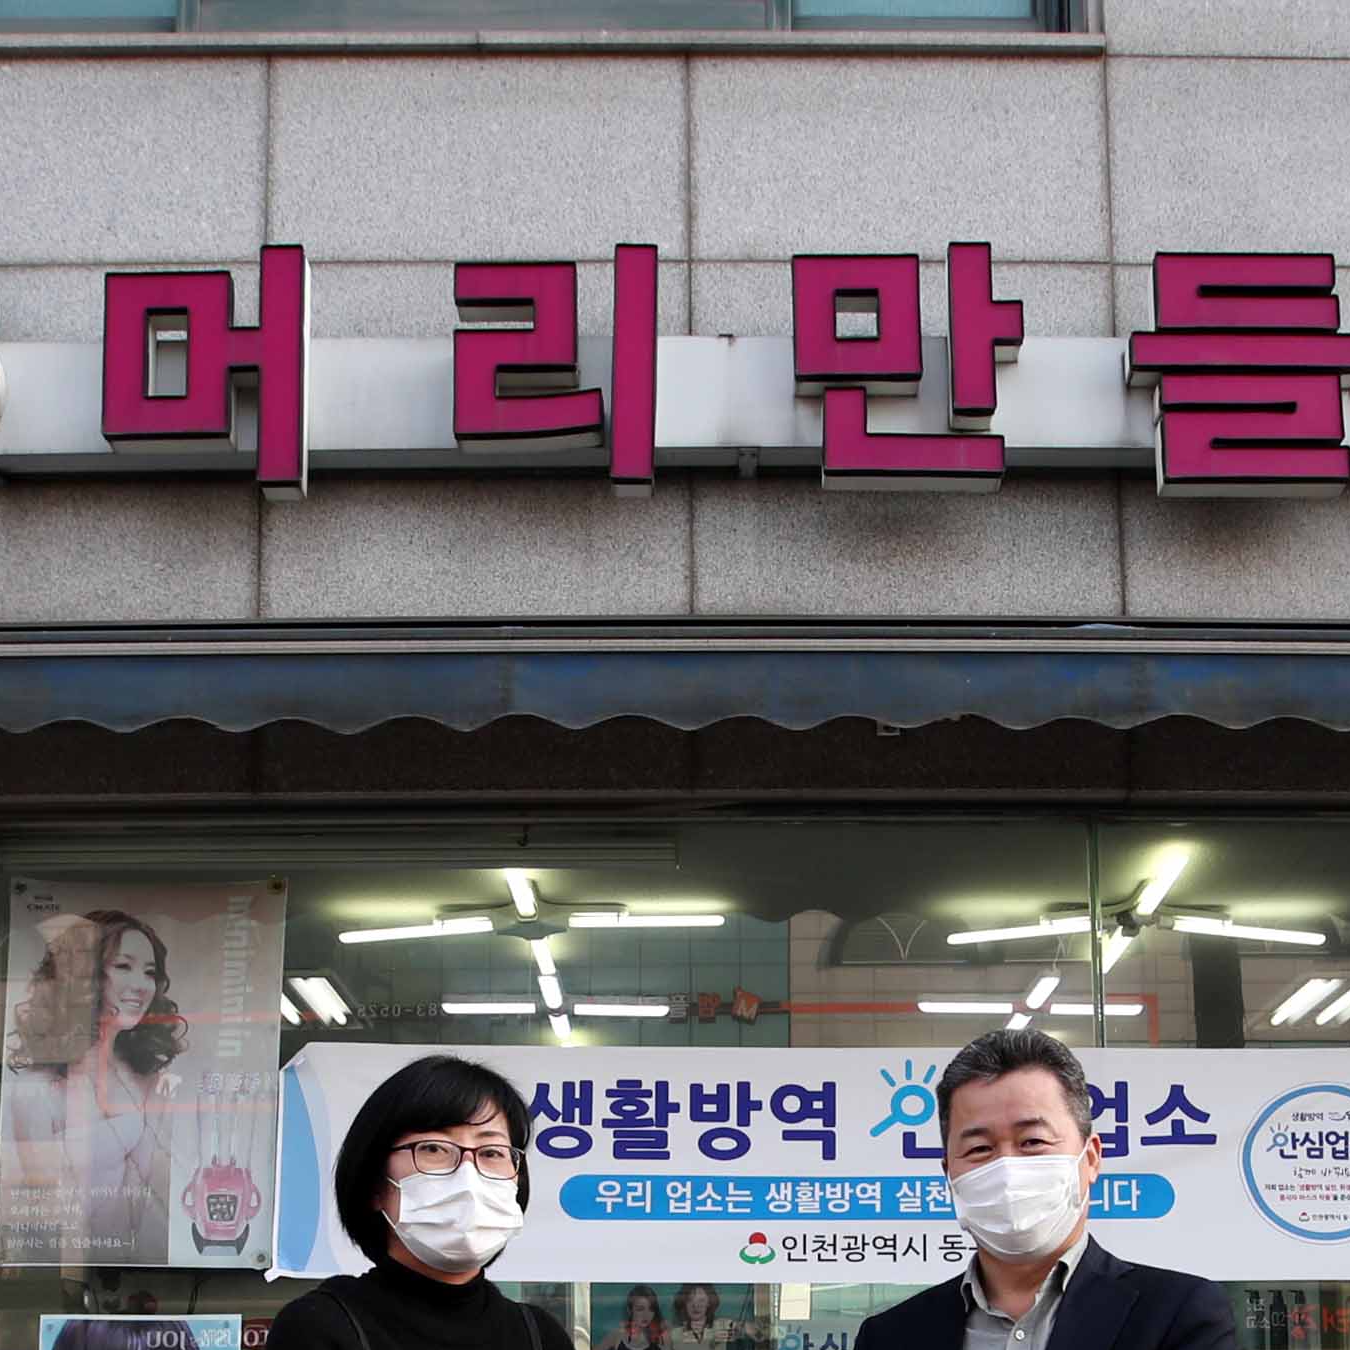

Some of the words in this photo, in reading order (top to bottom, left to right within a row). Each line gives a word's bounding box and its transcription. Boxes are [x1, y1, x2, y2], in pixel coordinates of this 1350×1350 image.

[529, 1079, 837, 1161] 생활방역
[595, 1181, 651, 1213] 우리
[666, 1181, 751, 1213] 업소는
[765, 1181, 883, 1213] 생활방역
[895, 1181, 953, 1213] 실천
[782, 1233, 928, 1264] 인천광역시
[938, 1233, 978, 1264] 동
